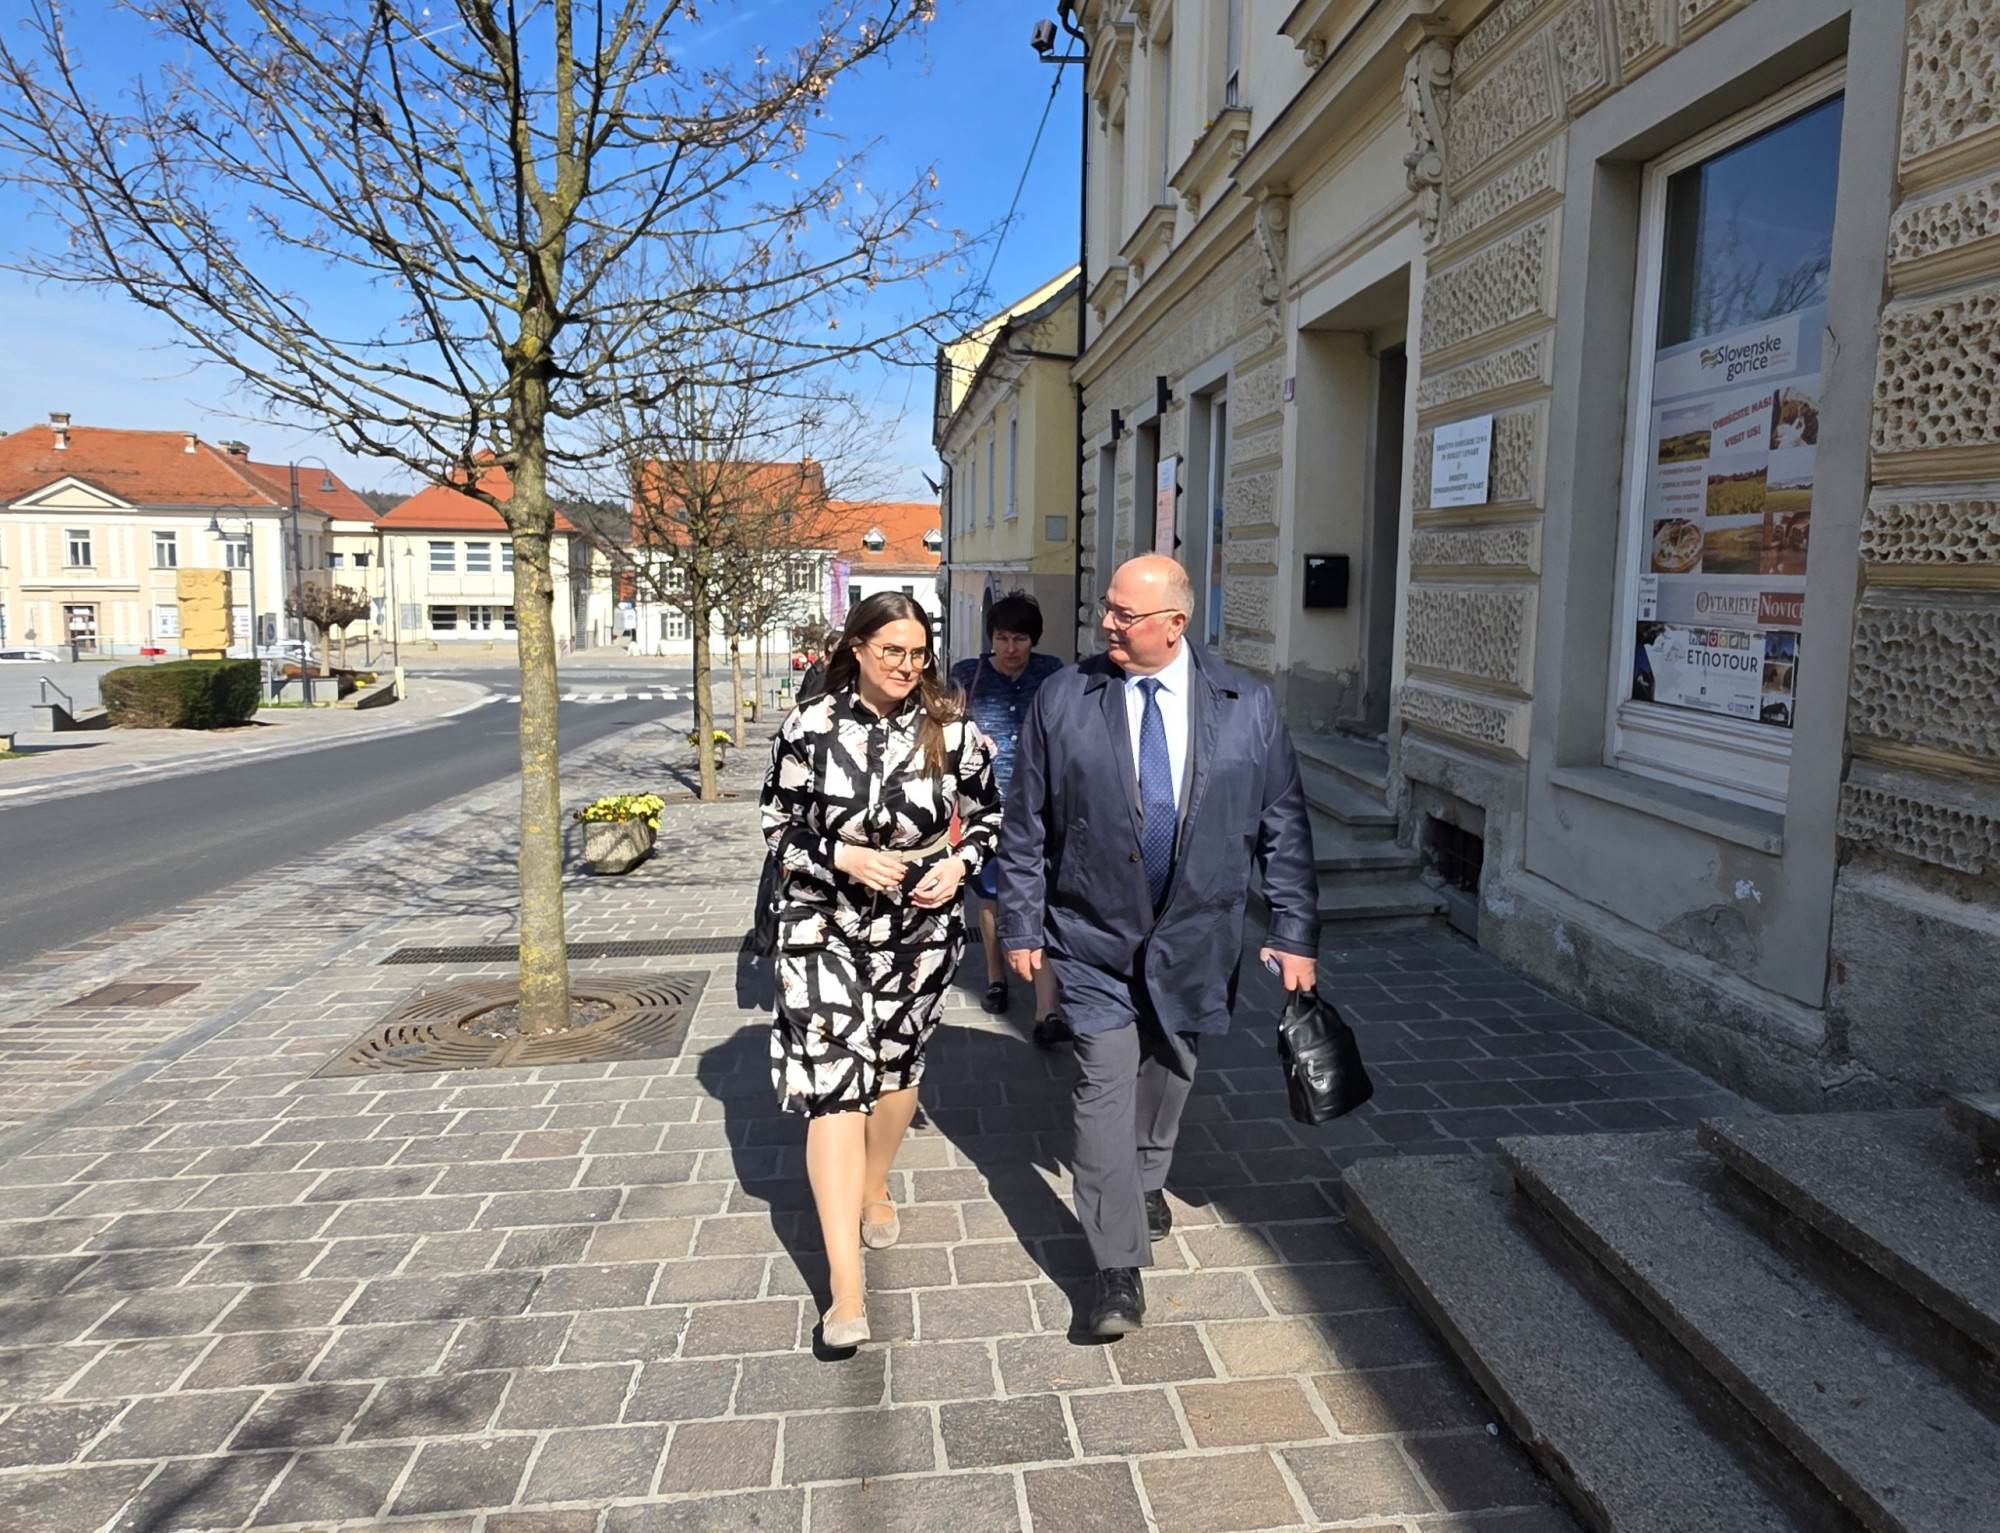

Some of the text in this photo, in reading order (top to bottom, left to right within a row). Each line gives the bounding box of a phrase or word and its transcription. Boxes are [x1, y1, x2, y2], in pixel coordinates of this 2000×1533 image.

[1717, 334, 1782, 364] Slovenske
[1726, 355, 1769, 382] gorice
[1751, 396, 1772, 413] NAS!
[1724, 424, 1761, 448] VISIT US!
[1696, 591, 1758, 614] OVTARJEVE
[1687, 649, 1758, 673] ETNOTOUR
